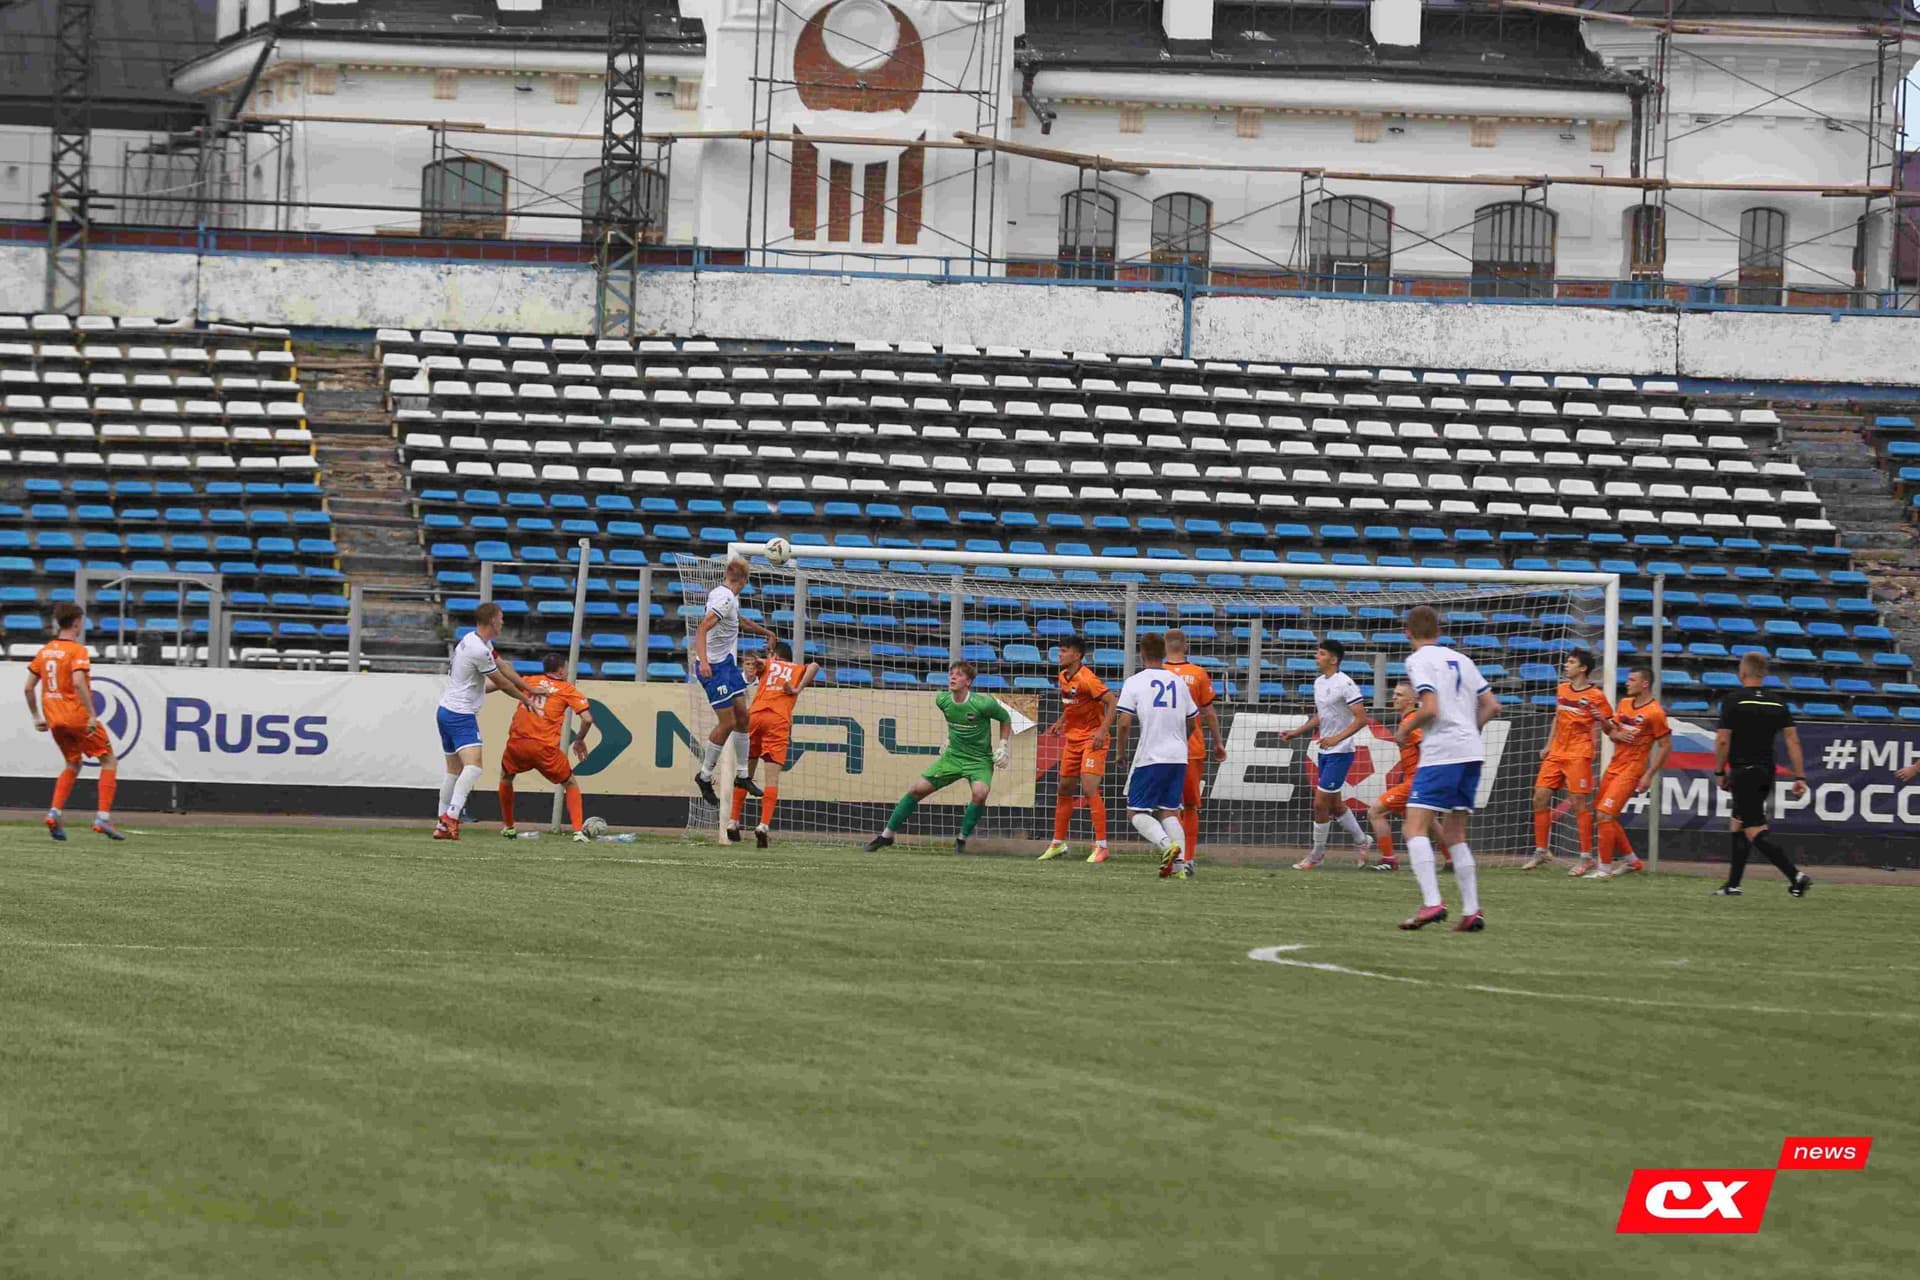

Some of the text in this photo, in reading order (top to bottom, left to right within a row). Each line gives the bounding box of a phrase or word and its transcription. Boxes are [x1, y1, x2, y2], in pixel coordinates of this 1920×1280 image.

[45, 660, 58, 691] 3
[766, 662, 793, 686] 24
[1446, 660, 1462, 693] 7
[1150, 679, 1177, 709] 21
